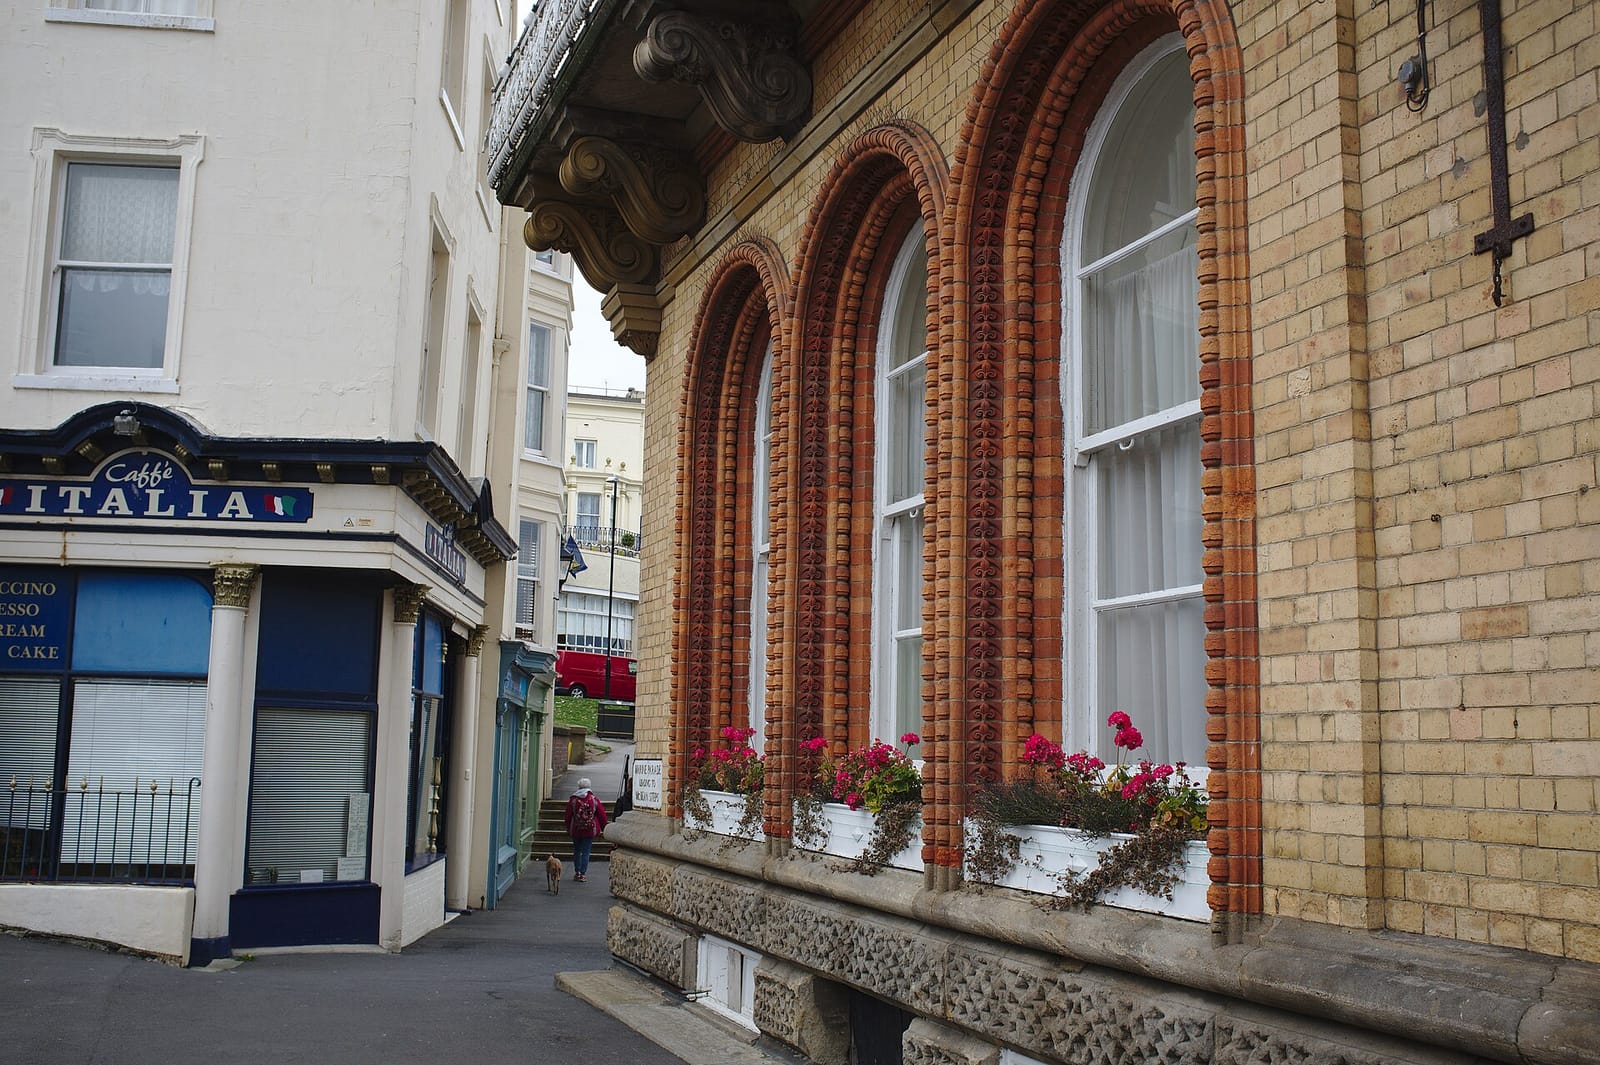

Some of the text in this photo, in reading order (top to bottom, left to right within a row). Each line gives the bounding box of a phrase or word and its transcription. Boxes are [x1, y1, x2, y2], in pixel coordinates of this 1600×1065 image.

[25, 485, 254, 519] ITALIA
[0, 581, 56, 596] CCINO
[0, 602, 40, 616] ESSO
[7, 645, 59, 659] CAKE
